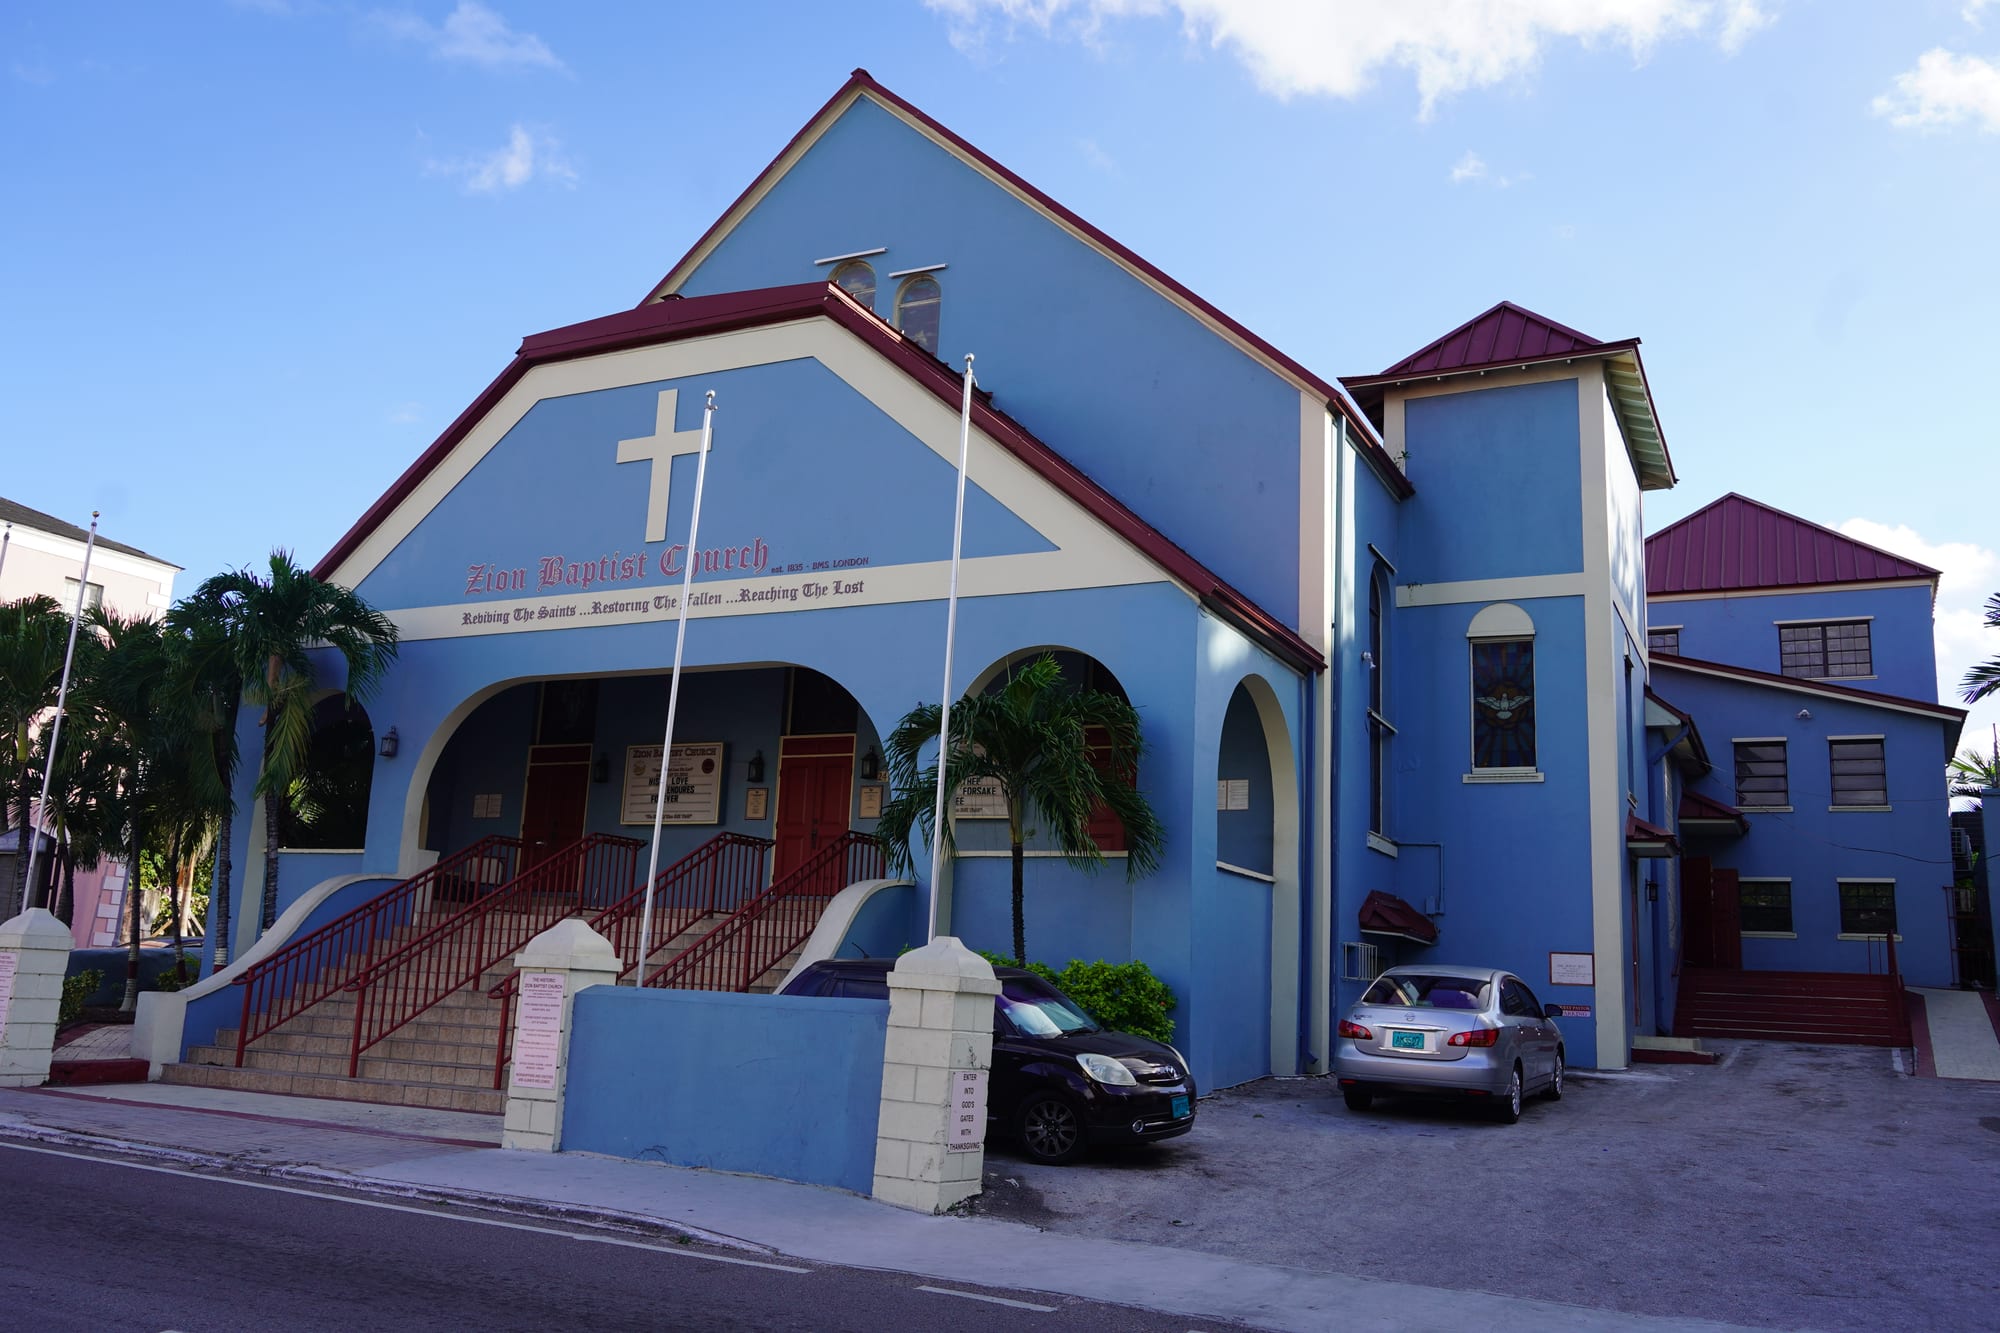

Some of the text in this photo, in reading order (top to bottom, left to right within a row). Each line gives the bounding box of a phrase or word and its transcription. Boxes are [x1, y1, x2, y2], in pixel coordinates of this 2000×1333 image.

[787, 563, 803, 572] 1835
[812, 560, 830, 570] BMS
[833, 556, 869, 569] LONDON
[464, 562, 527, 596] Zion
[537, 551, 648, 593] Baptist
[513, 607, 534, 622] The
[537, 604, 577, 620] Saints
[653, 595, 677, 611] The
[802, 582, 829, 599] The
[833, 580, 865, 595] Lost
[685, 747, 717, 756] CHURCH
[671, 776, 689, 785] LOVE
[667, 785, 695, 794] ENDURES
[962, 786, 997, 795] FORSAKE
[651, 794, 679, 803] FOEVER
[963, 1073, 977, 1081] ENTER
[964, 1087, 974, 1095] INTO
[962, 1101, 975, 1109] GOD'S
[960, 1114, 974, 1122] GATES
[961, 1128, 971, 1136] WITH
[950, 1142, 980, 1151] THANKSGIVING
